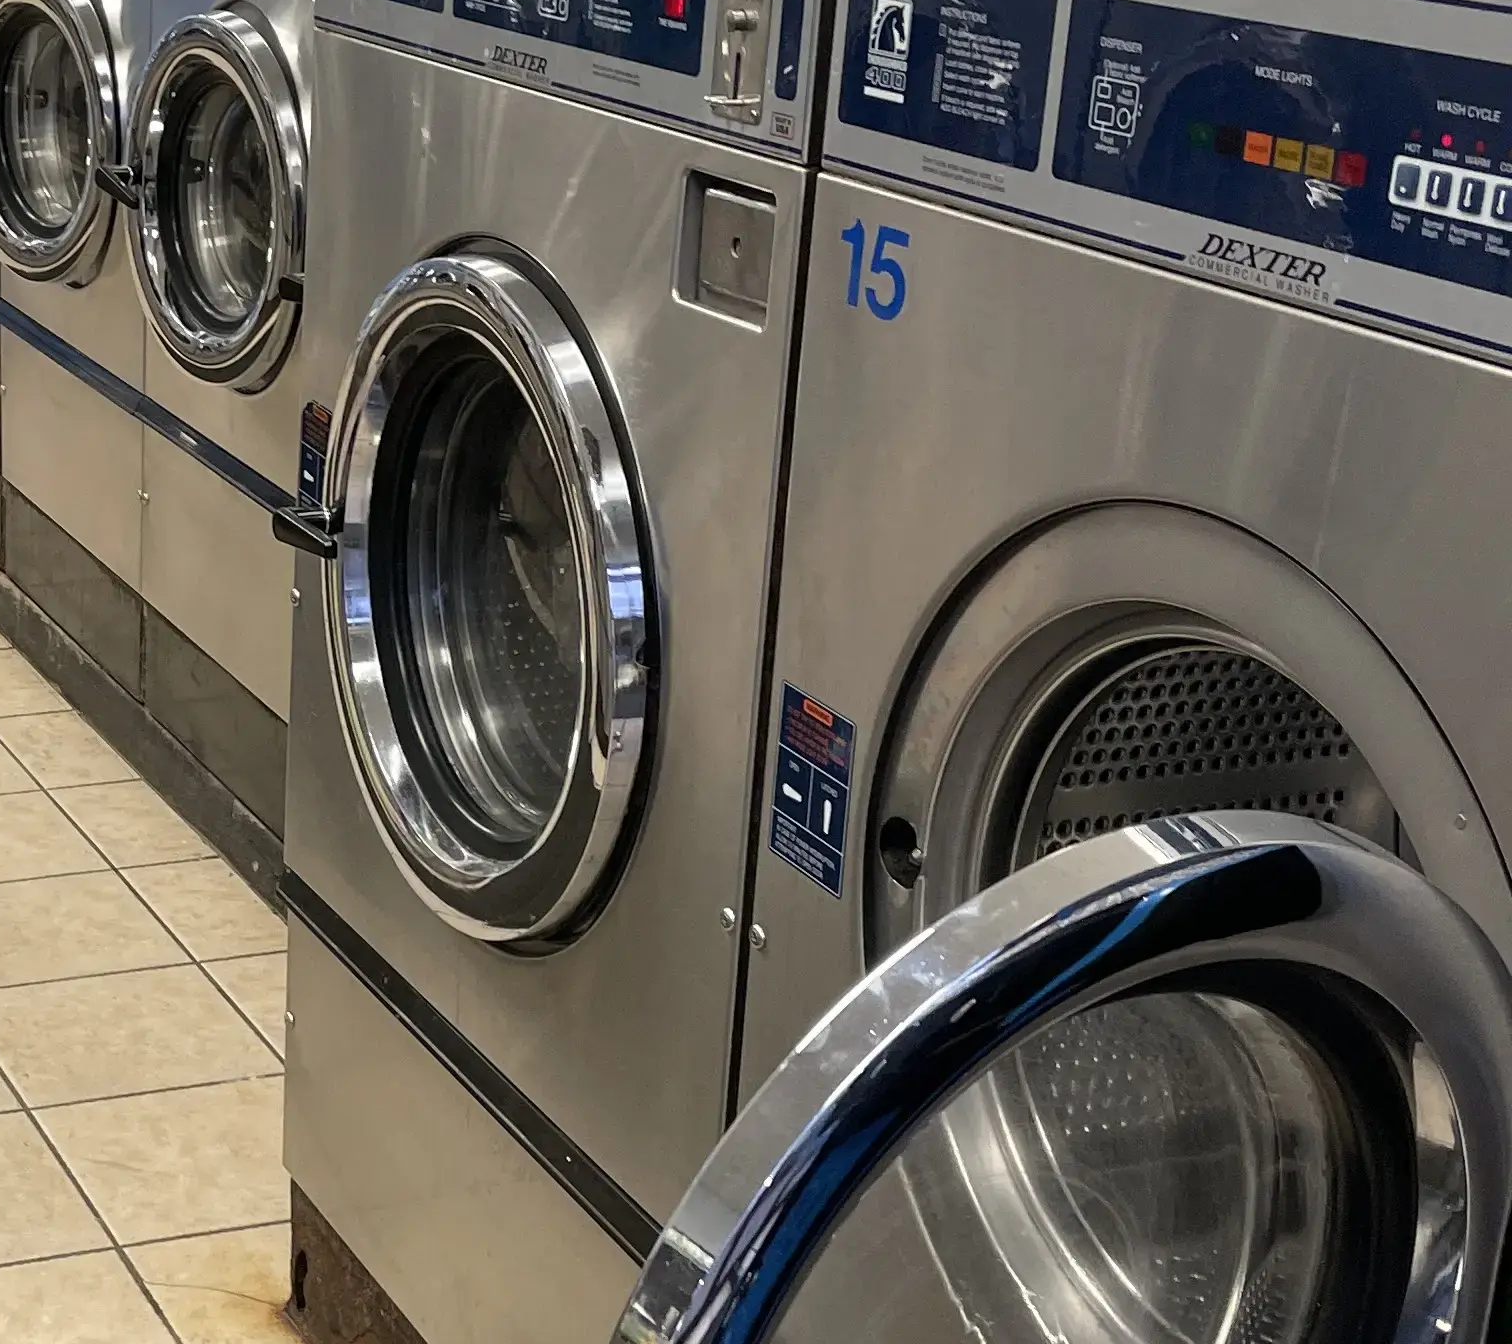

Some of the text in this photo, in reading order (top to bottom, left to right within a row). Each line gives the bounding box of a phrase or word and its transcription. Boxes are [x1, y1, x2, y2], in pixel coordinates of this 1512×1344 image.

[491, 45, 548, 74] DEXTER
[864, 65, 907, 92] 400
[1254, 64, 1313, 87] MODE LIGHTS
[1437, 99, 1502, 123] WASH CYCLE
[841, 218, 912, 321] 15
[1197, 233, 1326, 286] DEXTER
[1188, 254, 1330, 303] COMMERCIAL WASHER
